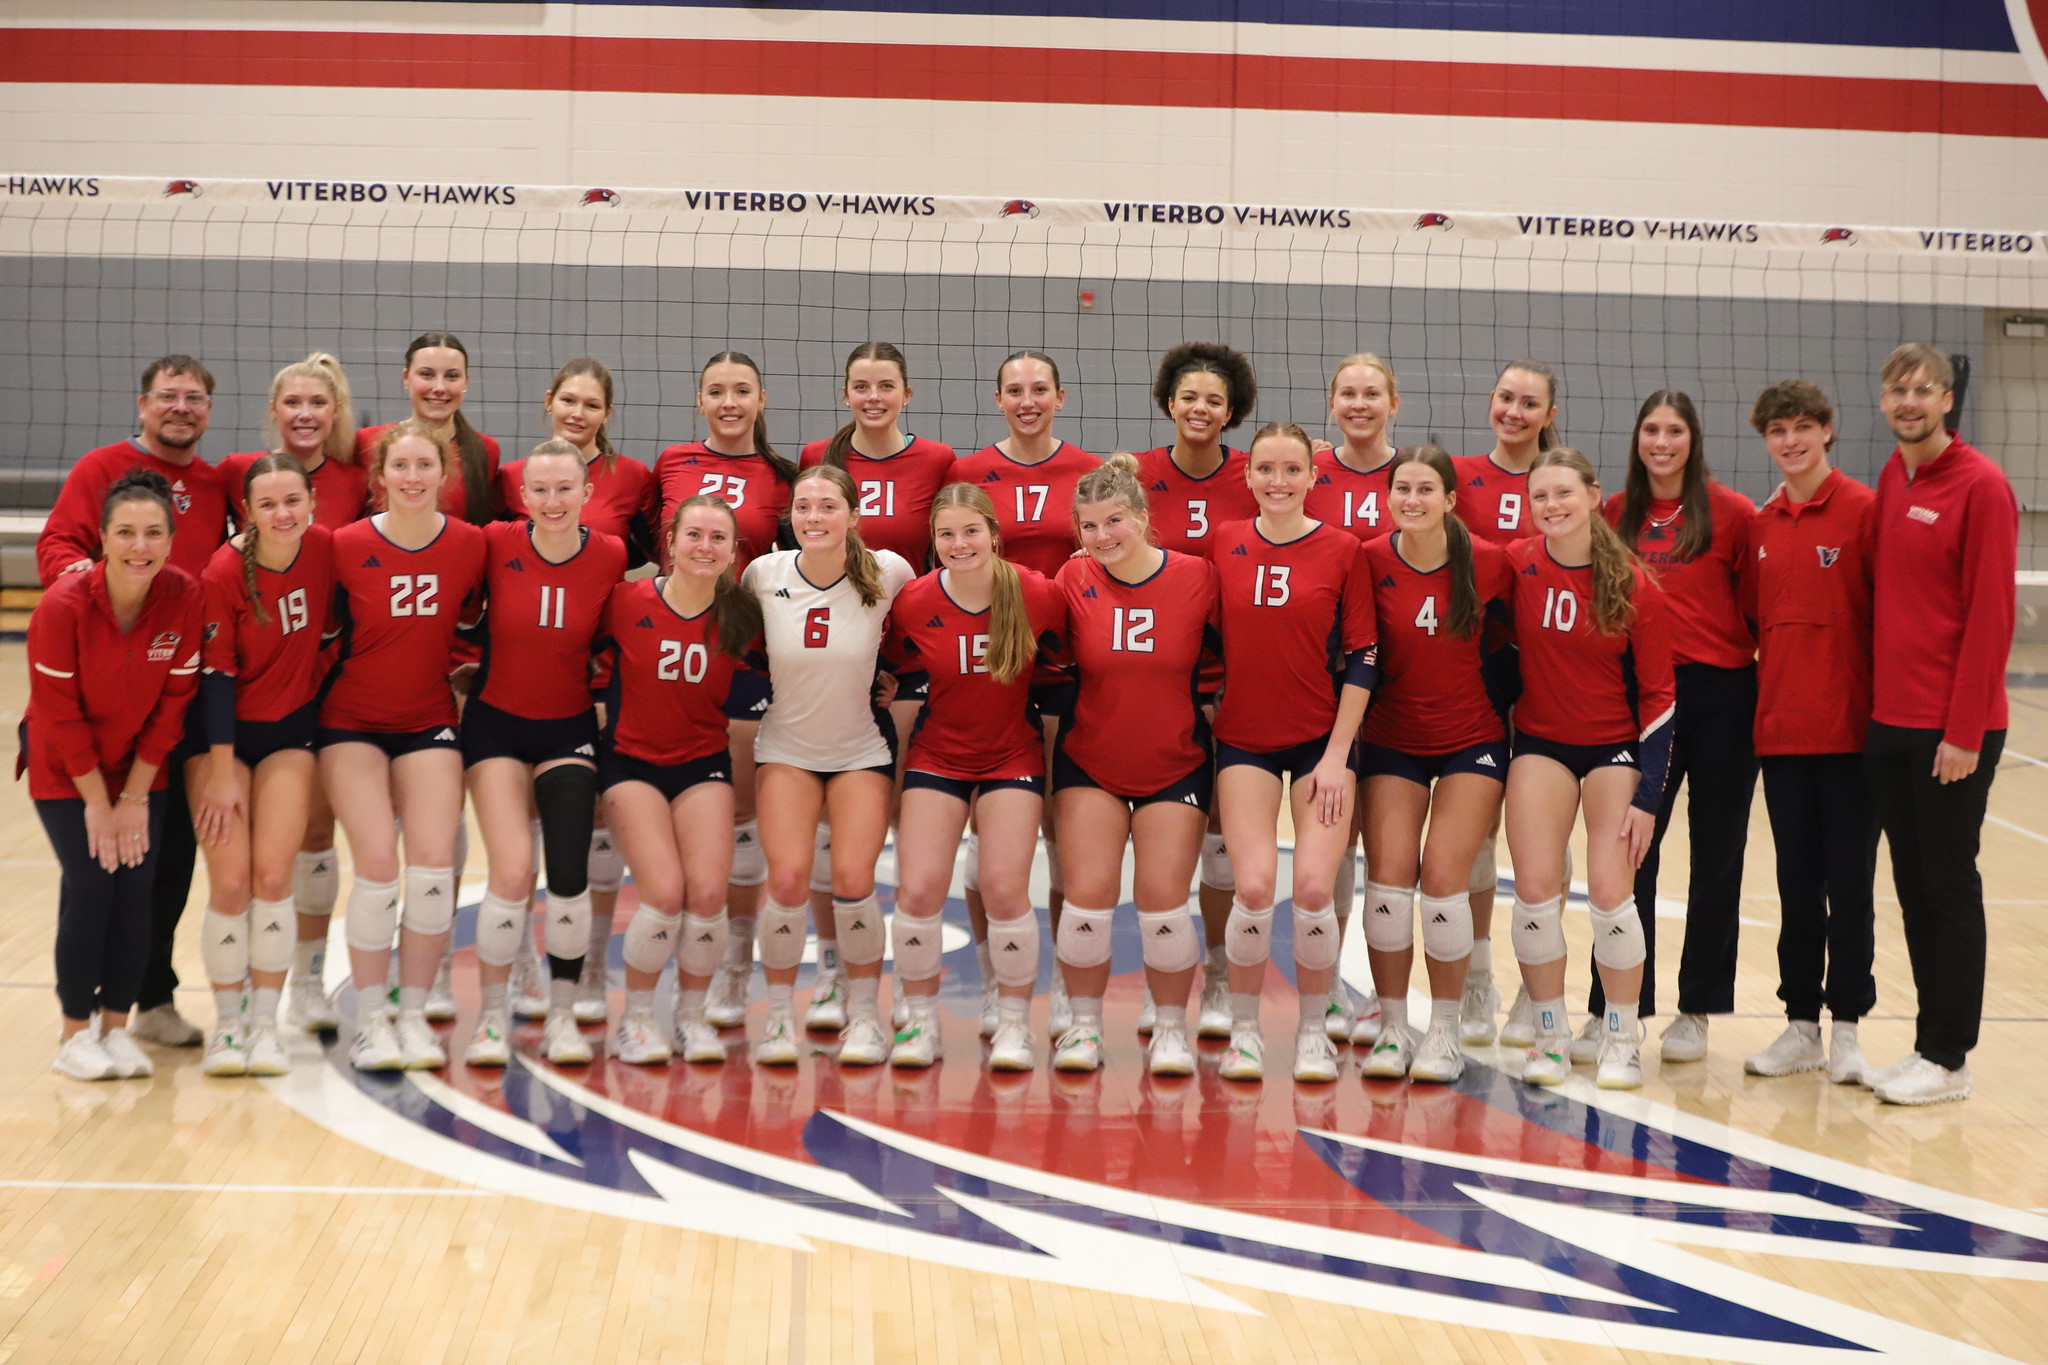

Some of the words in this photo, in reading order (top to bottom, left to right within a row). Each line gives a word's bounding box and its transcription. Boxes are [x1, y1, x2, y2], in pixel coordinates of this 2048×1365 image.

[0, 176, 100, 197] -HAWKS
[267, 181, 388, 203] VITERBO
[396, 184, 516, 206] V-HAWKS
[684, 190, 807, 213] VITERBO
[815, 194, 936, 217] V-HAWKS
[1103, 202, 1225, 225] VITERBO
[1233, 206, 1351, 229] V-HAWKS
[1517, 215, 1635, 239] VITERBO
[1644, 220, 1759, 243] V-HAWKS
[1919, 231, 2034, 253] VITERBO
[697, 472, 748, 512] 23
[857, 479, 896, 518] 21
[1013, 484, 1051, 523] 17
[1342, 490, 1381, 528] 14
[1496, 492, 1523, 531] 9
[1185, 499, 1210, 539] 3
[389, 573, 440, 618] 22
[1252, 564, 1292, 608] 13
[277, 586, 309, 637] 19
[537, 584, 566, 630] 11
[1413, 595, 1439, 637] 4
[1541, 586, 1578, 633] 10
[804, 607, 829, 648] 6
[1110, 606, 1155, 654] 12
[656, 638, 709, 685] 20
[957, 633, 991, 675] 15
